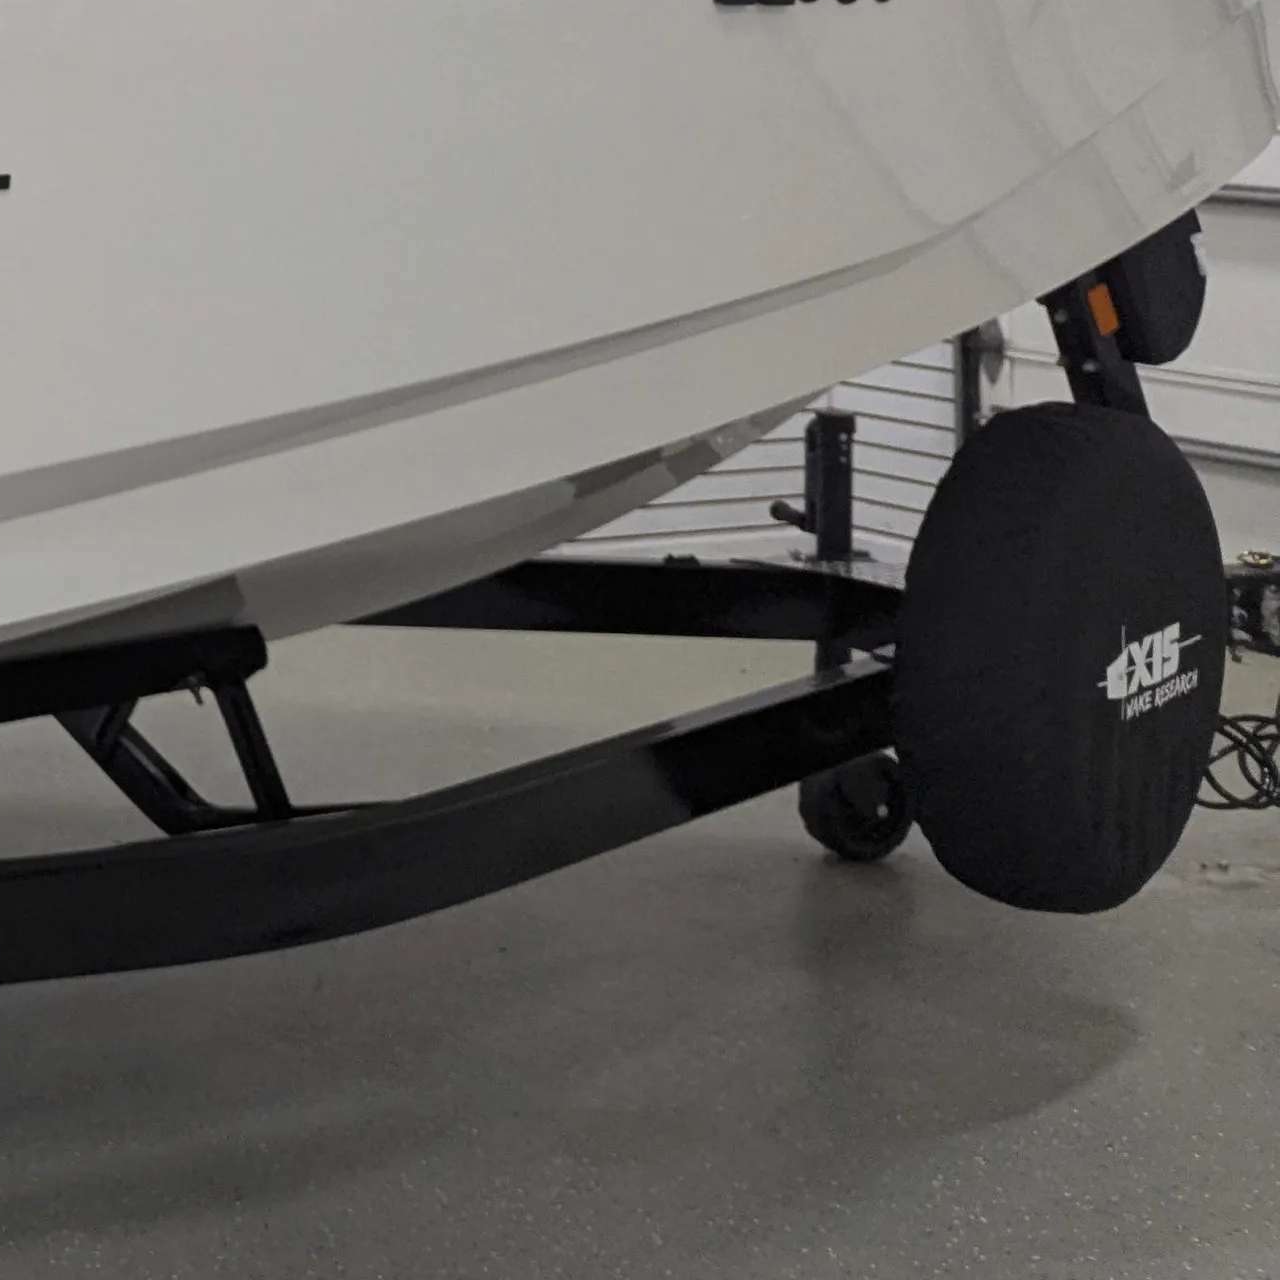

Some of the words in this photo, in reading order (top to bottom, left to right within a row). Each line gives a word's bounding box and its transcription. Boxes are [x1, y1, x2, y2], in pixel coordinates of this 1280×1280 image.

[1106, 621, 1181, 700] AXIS
[1126, 690, 1153, 720] WAKE
[1154, 668, 1198, 708] RESEARCH
